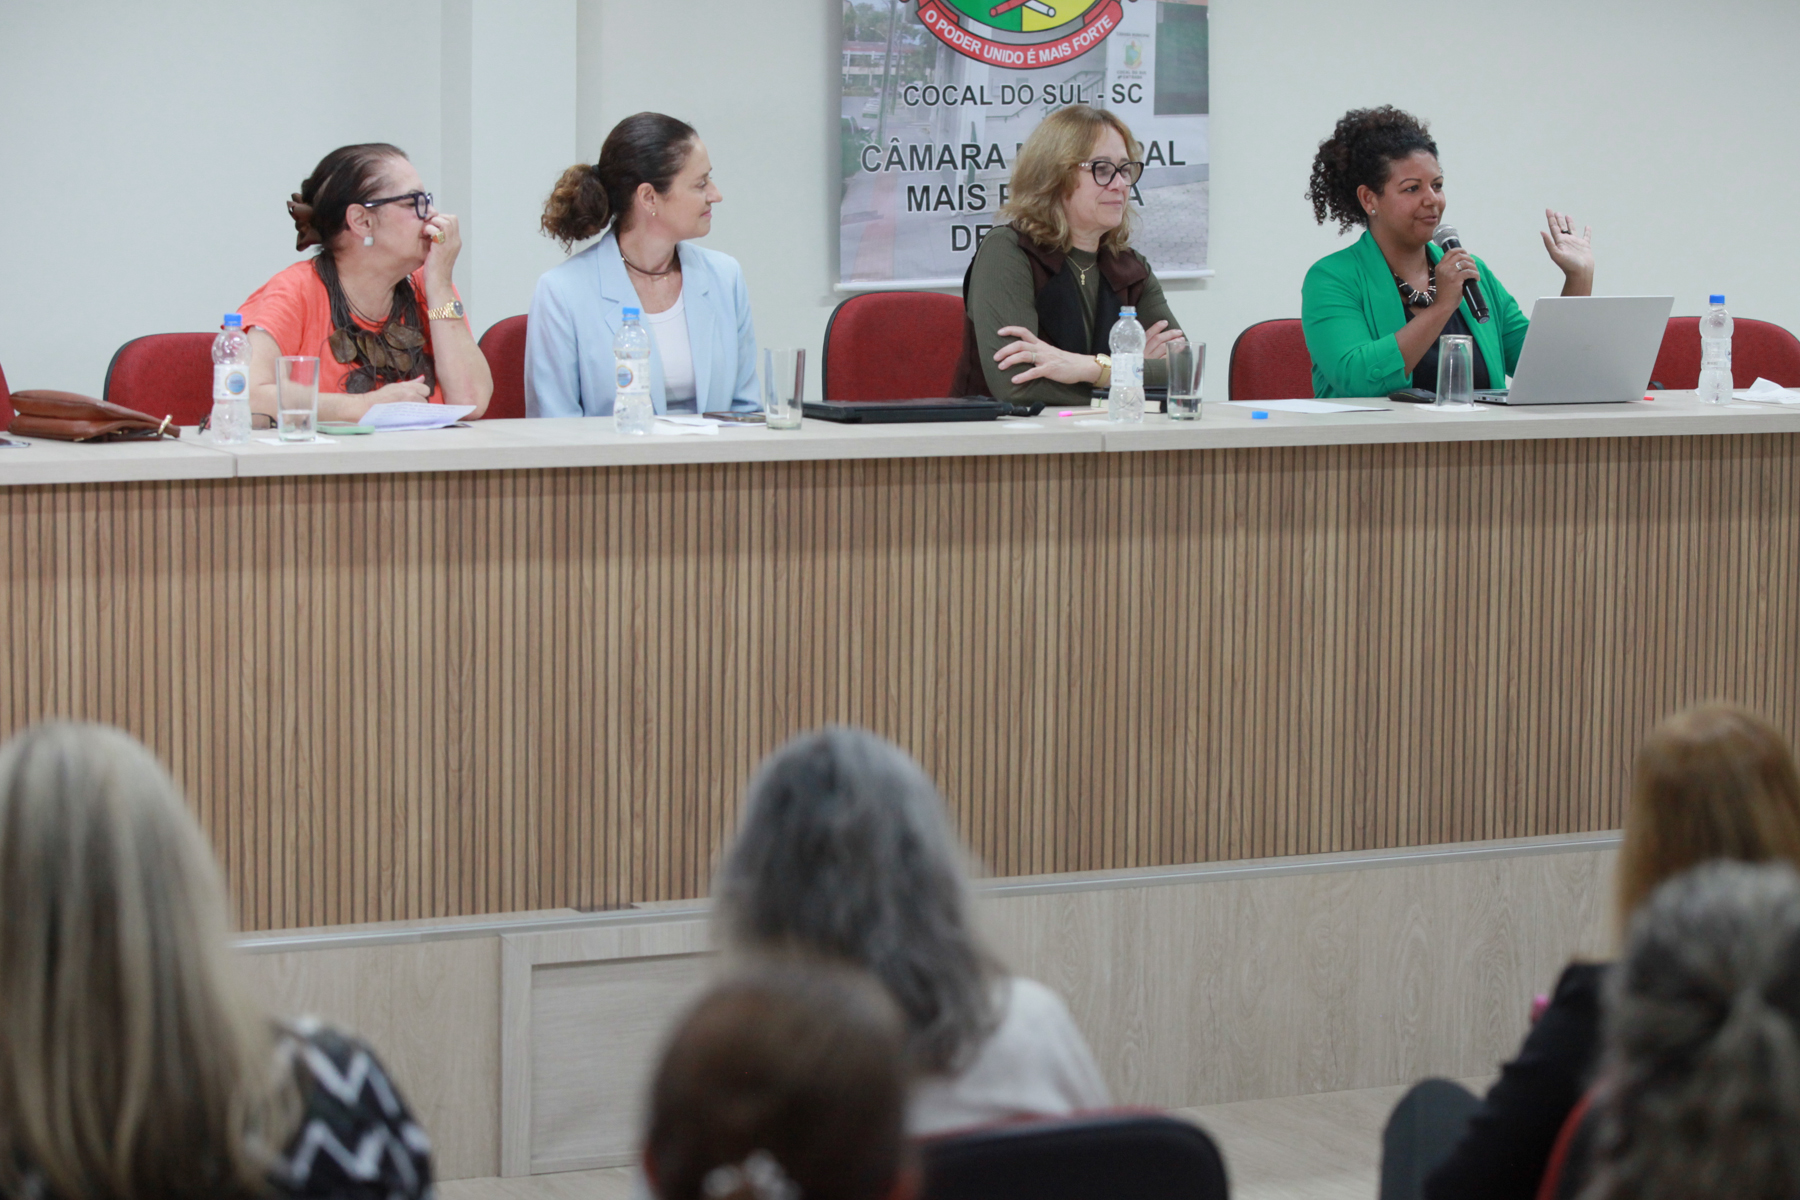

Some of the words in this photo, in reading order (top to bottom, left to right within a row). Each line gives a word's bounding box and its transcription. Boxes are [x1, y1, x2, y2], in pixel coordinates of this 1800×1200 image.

[925, 10, 938, 24] O
[935, 19, 982, 55] PODER
[983, 45, 1024, 65] UNIDO
[1027, 48, 1037, 65] É
[1038, 42, 1072, 63] MAIS
[1072, 15, 1113, 51] FORTE
[903, 84, 994, 107] COCAL
[1001, 84, 1035, 105] DO
[1042, 84, 1090, 105] SUL
[1111, 83, 1143, 104] SC
[861, 137, 1007, 173] CÂMARA
[907, 184, 987, 212] MAIS
